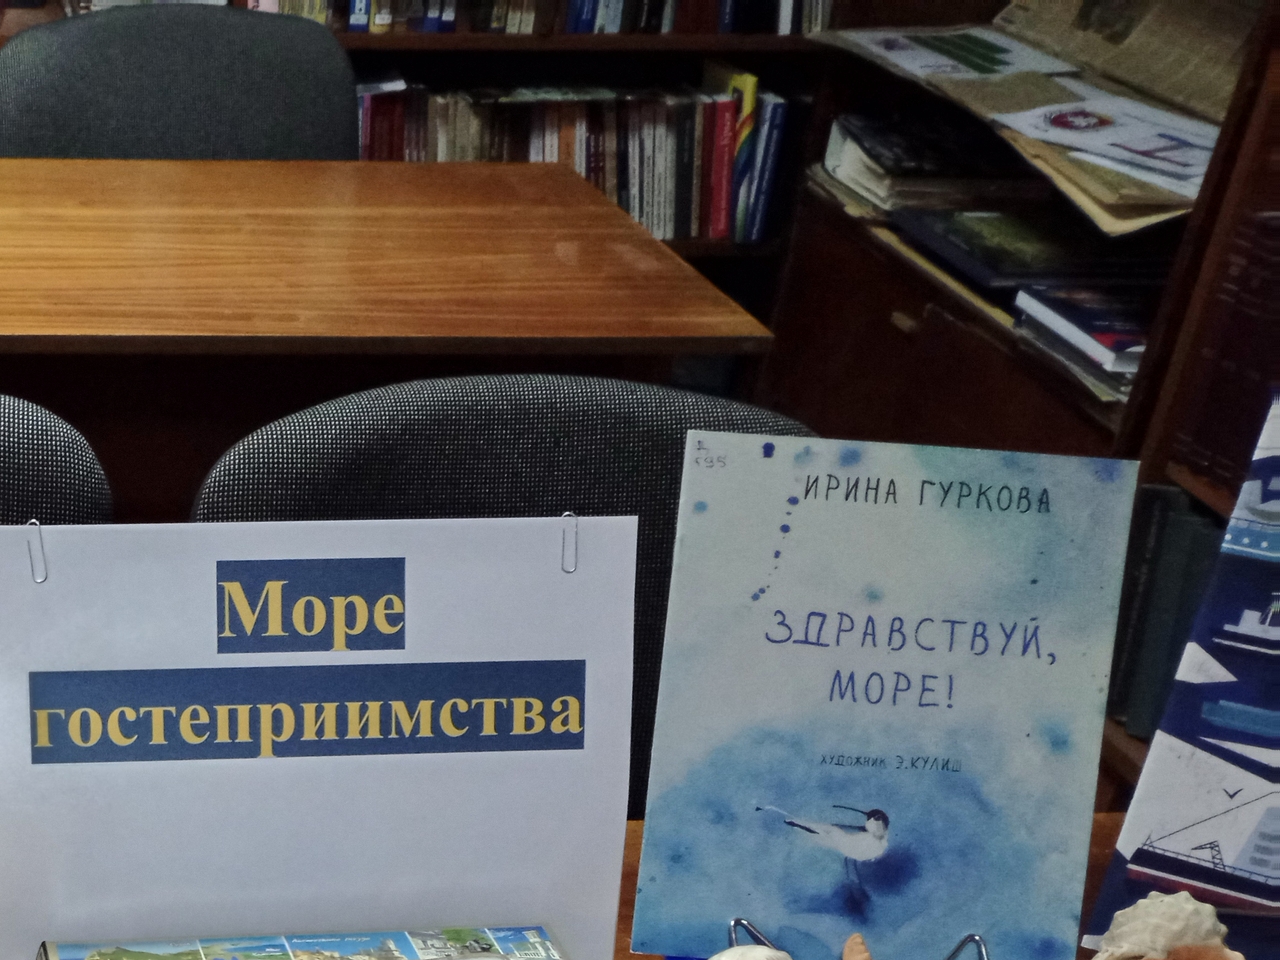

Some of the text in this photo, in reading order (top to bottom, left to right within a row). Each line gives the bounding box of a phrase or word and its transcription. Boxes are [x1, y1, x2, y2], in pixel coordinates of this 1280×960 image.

[803, 474, 1052, 514] ИРИНА ГУРКОВА
[218, 579, 405, 652] Море
[764, 608, 1058, 666] ЗДРАВСТВУЙ,
[829, 669, 955, 709] МОРЕ!
[32, 693, 585, 759] гостеприимства
[820, 754, 962, 773] ХУДОЖНИК Э.КУЛИШ
